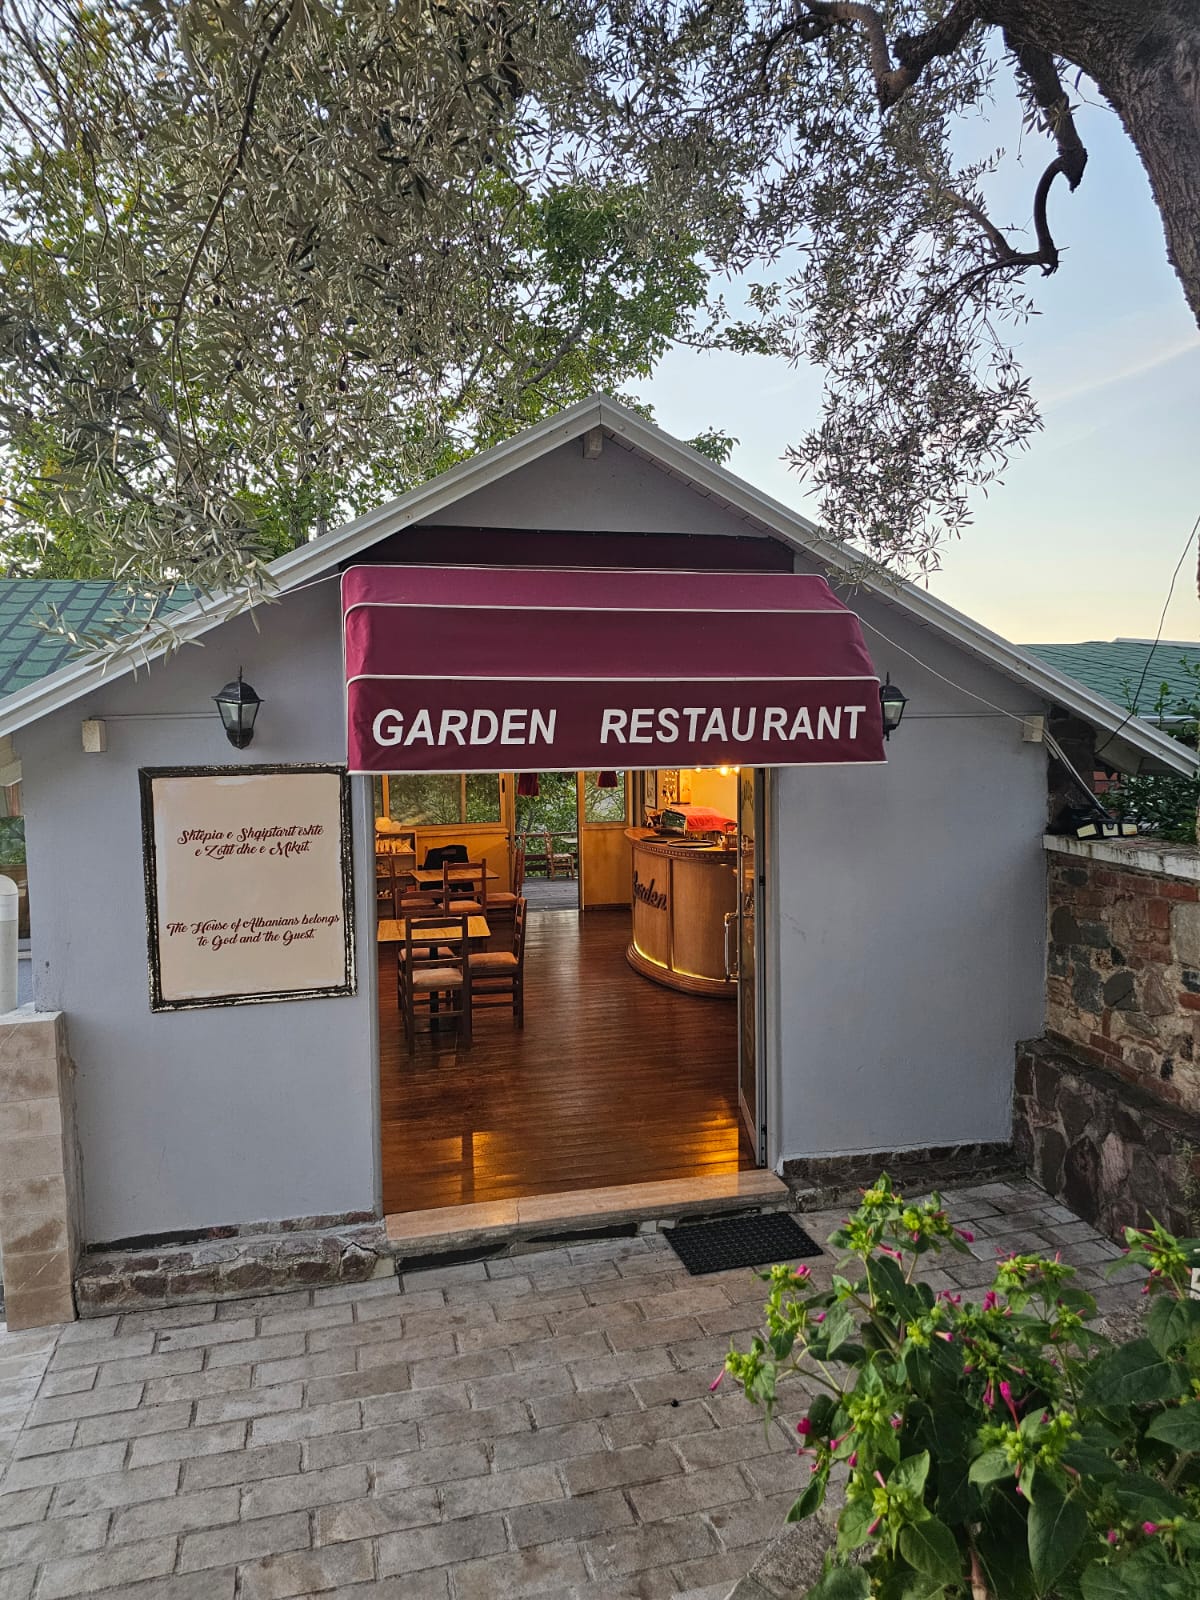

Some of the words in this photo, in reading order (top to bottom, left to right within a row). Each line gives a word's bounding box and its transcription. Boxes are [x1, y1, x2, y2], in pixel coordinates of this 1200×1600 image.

[371, 708, 558, 747] GARDEN
[600, 705, 867, 744] RESTAURANT
[226, 830, 234, 840] e
[194, 848, 202, 857] e
[236, 843, 257, 855] dhe
[259, 845, 266, 854] e
[166, 922, 188, 936] The
[190, 919, 229, 934] House
[231, 918, 242, 932] of
[242, 917, 300, 933] Albanians
[301, 914, 340, 926] belongs
[197, 935, 209, 947] to
[212, 934, 238, 951] God
[240, 932, 262, 943] and
[262, 931, 280, 942] the
